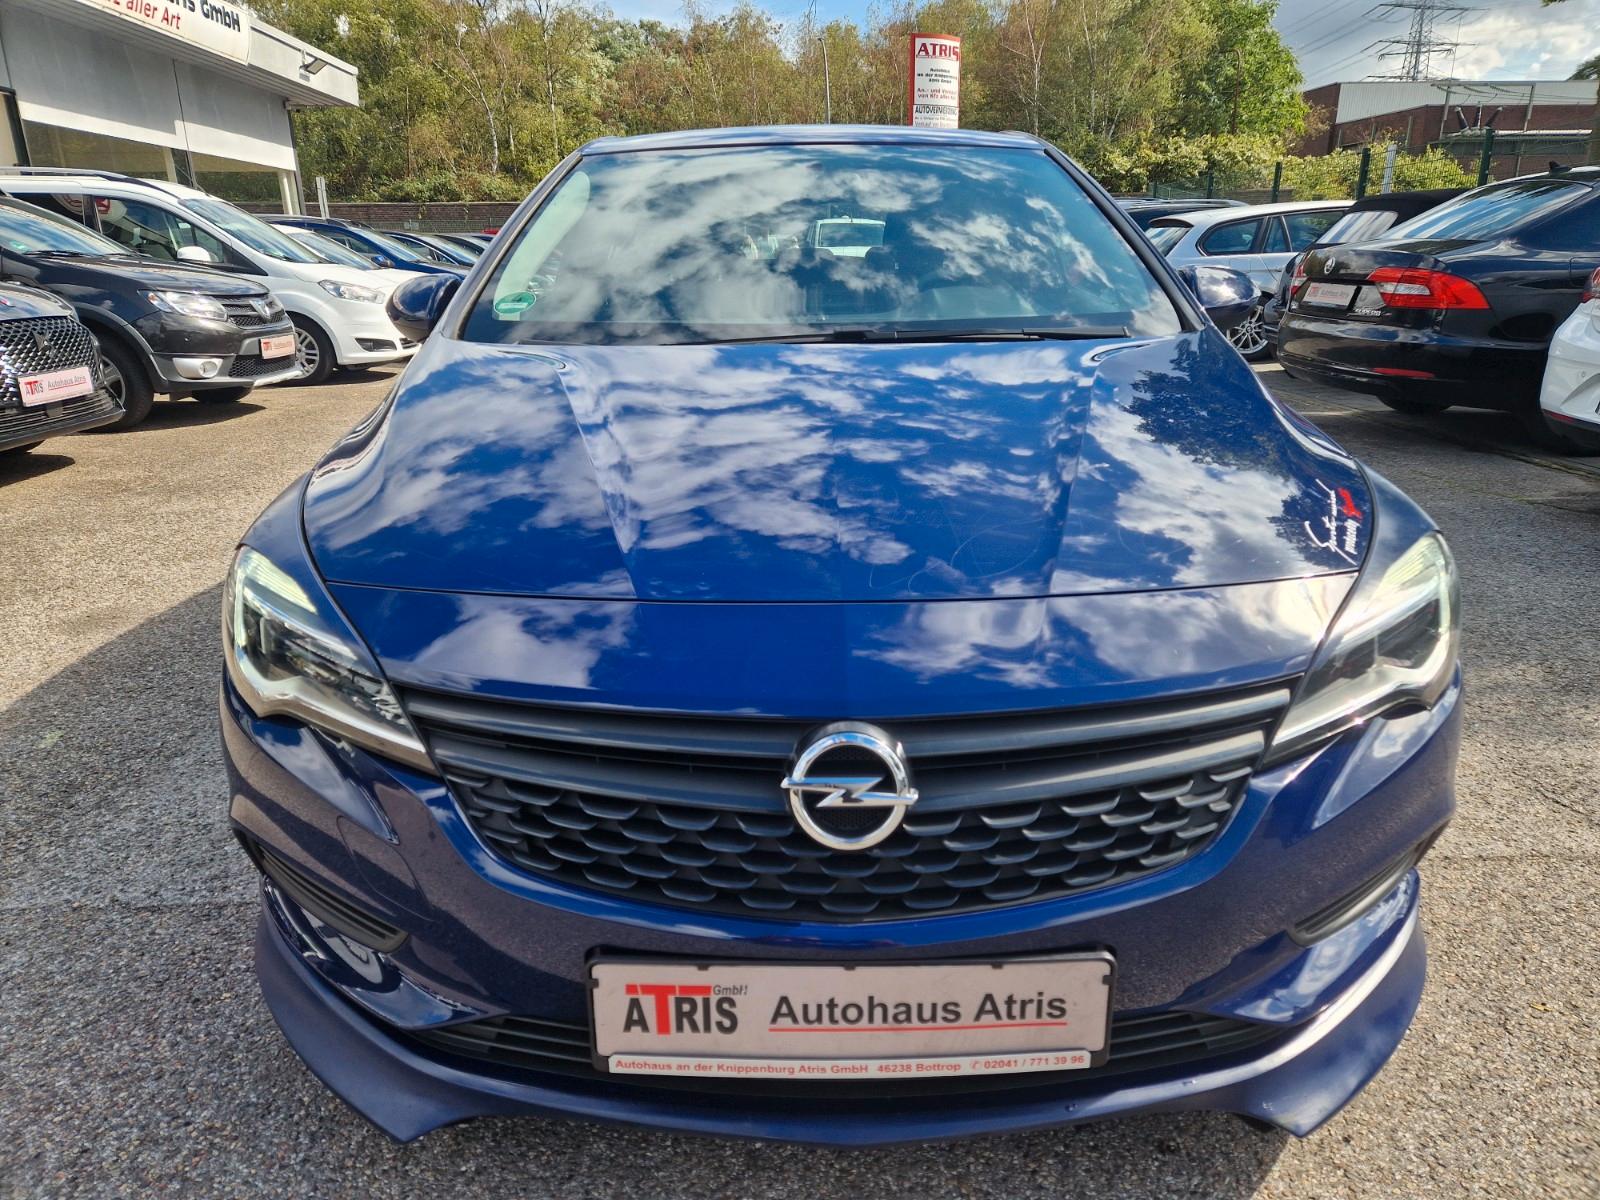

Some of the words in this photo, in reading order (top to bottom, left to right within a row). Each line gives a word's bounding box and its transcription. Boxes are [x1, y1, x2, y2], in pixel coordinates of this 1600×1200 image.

[126, 0, 158, 19] aller
[161, 6, 181, 30] Art
[200, 0, 241, 32] GmbH
[917, 42, 959, 61] ATRIS
[623, 984, 738, 1035] ATRIS
[712, 984, 748, 996] GmbH
[770, 995, 962, 1026] Autohaus
[973, 991, 1068, 1022] Atris
[614, 1059, 673, 1071] Autohaus
[676, 1063, 691, 1072] an
[694, 1063, 713, 1072] der
[716, 1063, 796, 1076] Knippenburg
[798, 1064, 827, 1074] Atris
[830, 1064, 869, 1074] GmbH
[876, 1063, 913, 1073] 46238
[915, 1062, 962, 1073] Bottrop
[983, 1060, 1018, 1070] 02041
[1030, 1057, 1049, 1067] 771
[1053, 1056, 1068, 1066] 39
